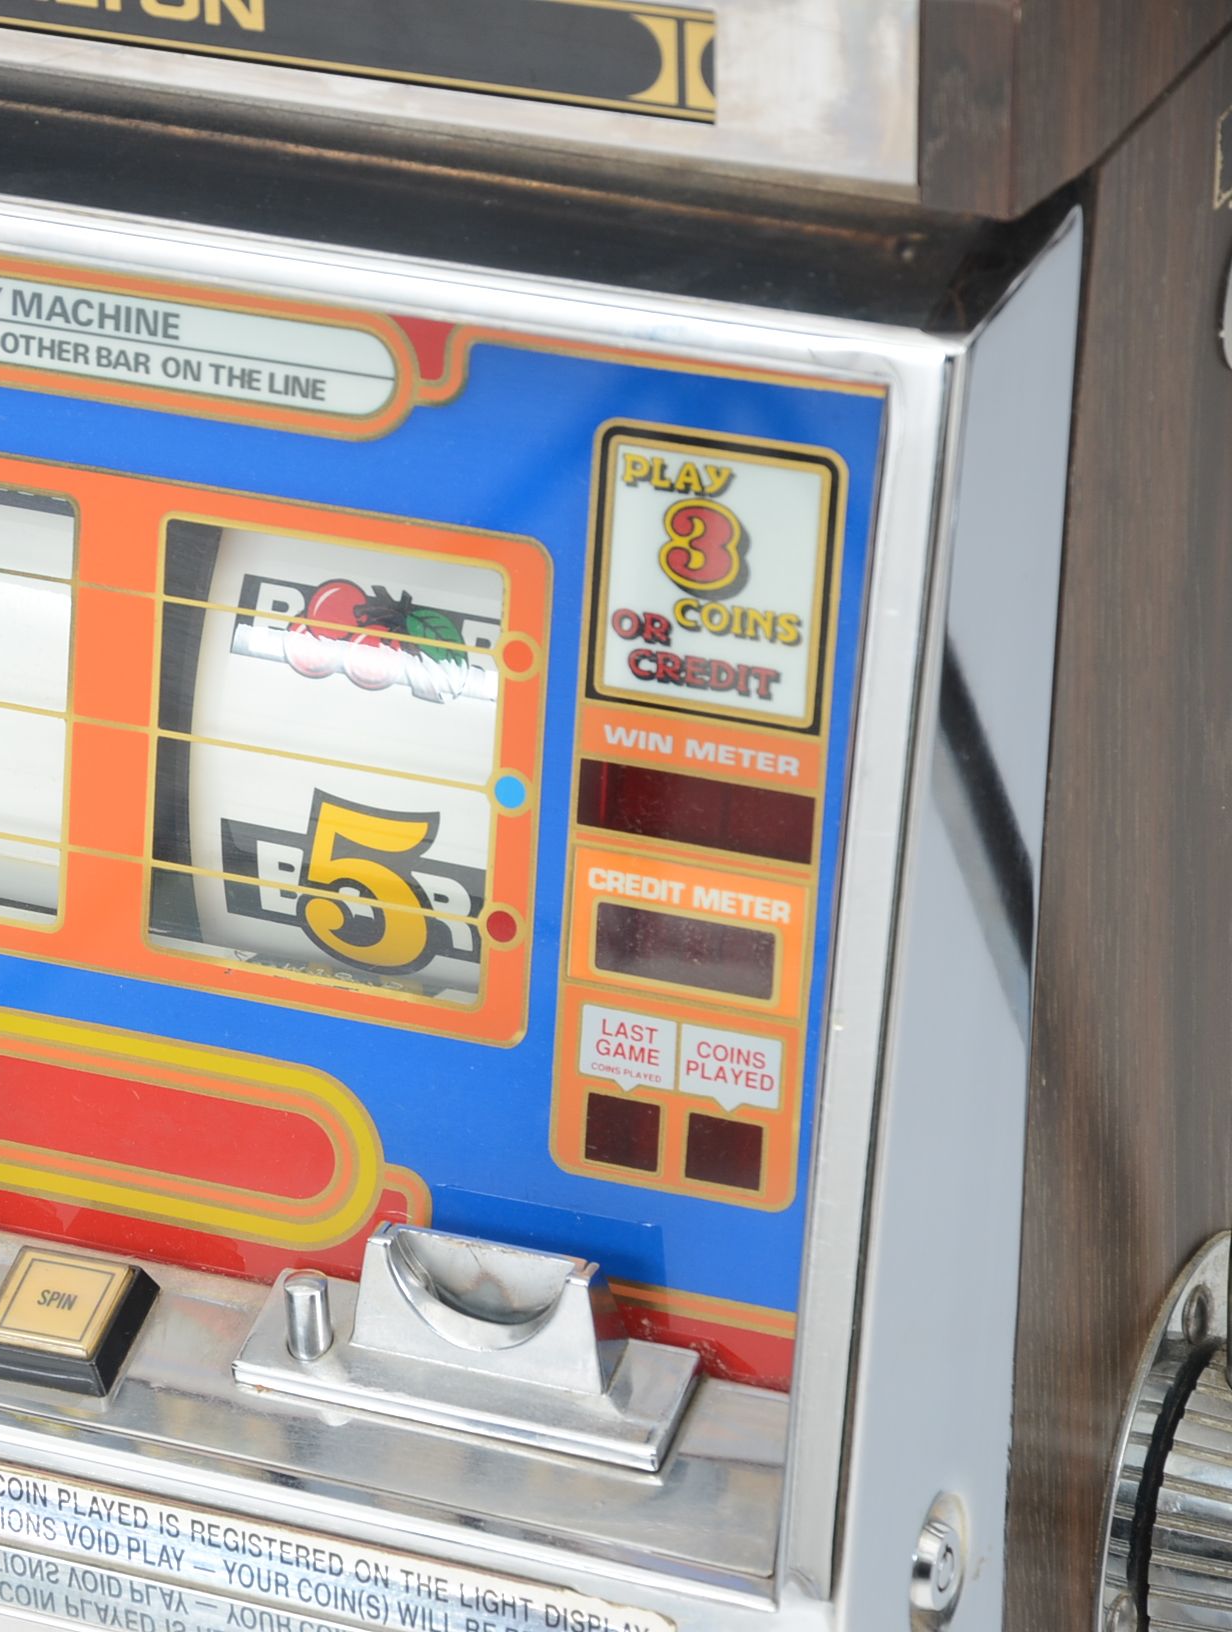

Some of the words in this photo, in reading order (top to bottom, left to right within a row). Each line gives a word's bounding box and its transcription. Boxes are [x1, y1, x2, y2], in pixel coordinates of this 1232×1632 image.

[12, 289, 180, 341] MACHINE
[0, 331, 89, 366] OTHER
[96, 346, 150, 375] BAR
[161, 356, 202, 382] ON
[209, 363, 262, 392] THE
[268, 371, 327, 402] LINE
[622, 452, 736, 496] PLAY
[659, 498, 751, 600] 3
[611, 608, 672, 646] OR
[673, 598, 802, 646] COINS
[628, 648, 781, 701] CREDIT
[603, 724, 673, 754] WIN
[685, 742, 800, 776] METER
[588, 867, 686, 905] CREDIT
[692, 885, 791, 924] METER
[595, 1038, 661, 1066] GAME
[601, 1018, 659, 1045] LAST
[696, 1040, 766, 1070] COINS
[591, 1062, 621, 1075] COINS
[623, 1068, 662, 1084] PLAYED
[685, 1060, 775, 1092] PLAYED
[37, 1288, 79, 1312] SPIN
[57, 1487, 148, 1530] PLAYED
[159, 1511, 180, 1539] IS
[191, 1519, 344, 1577] REGISTERED
[354, 1558, 390, 1589] ON
[400, 1568, 449, 1602] THE
[460, 1583, 533, 1622] LIGHT
[64, 1521, 120, 1556] VOID
[127, 1540, 185, 1572] PLAY
[223, 1559, 290, 1599] YOUR
[297, 1578, 389, 1626] COIN(S)
